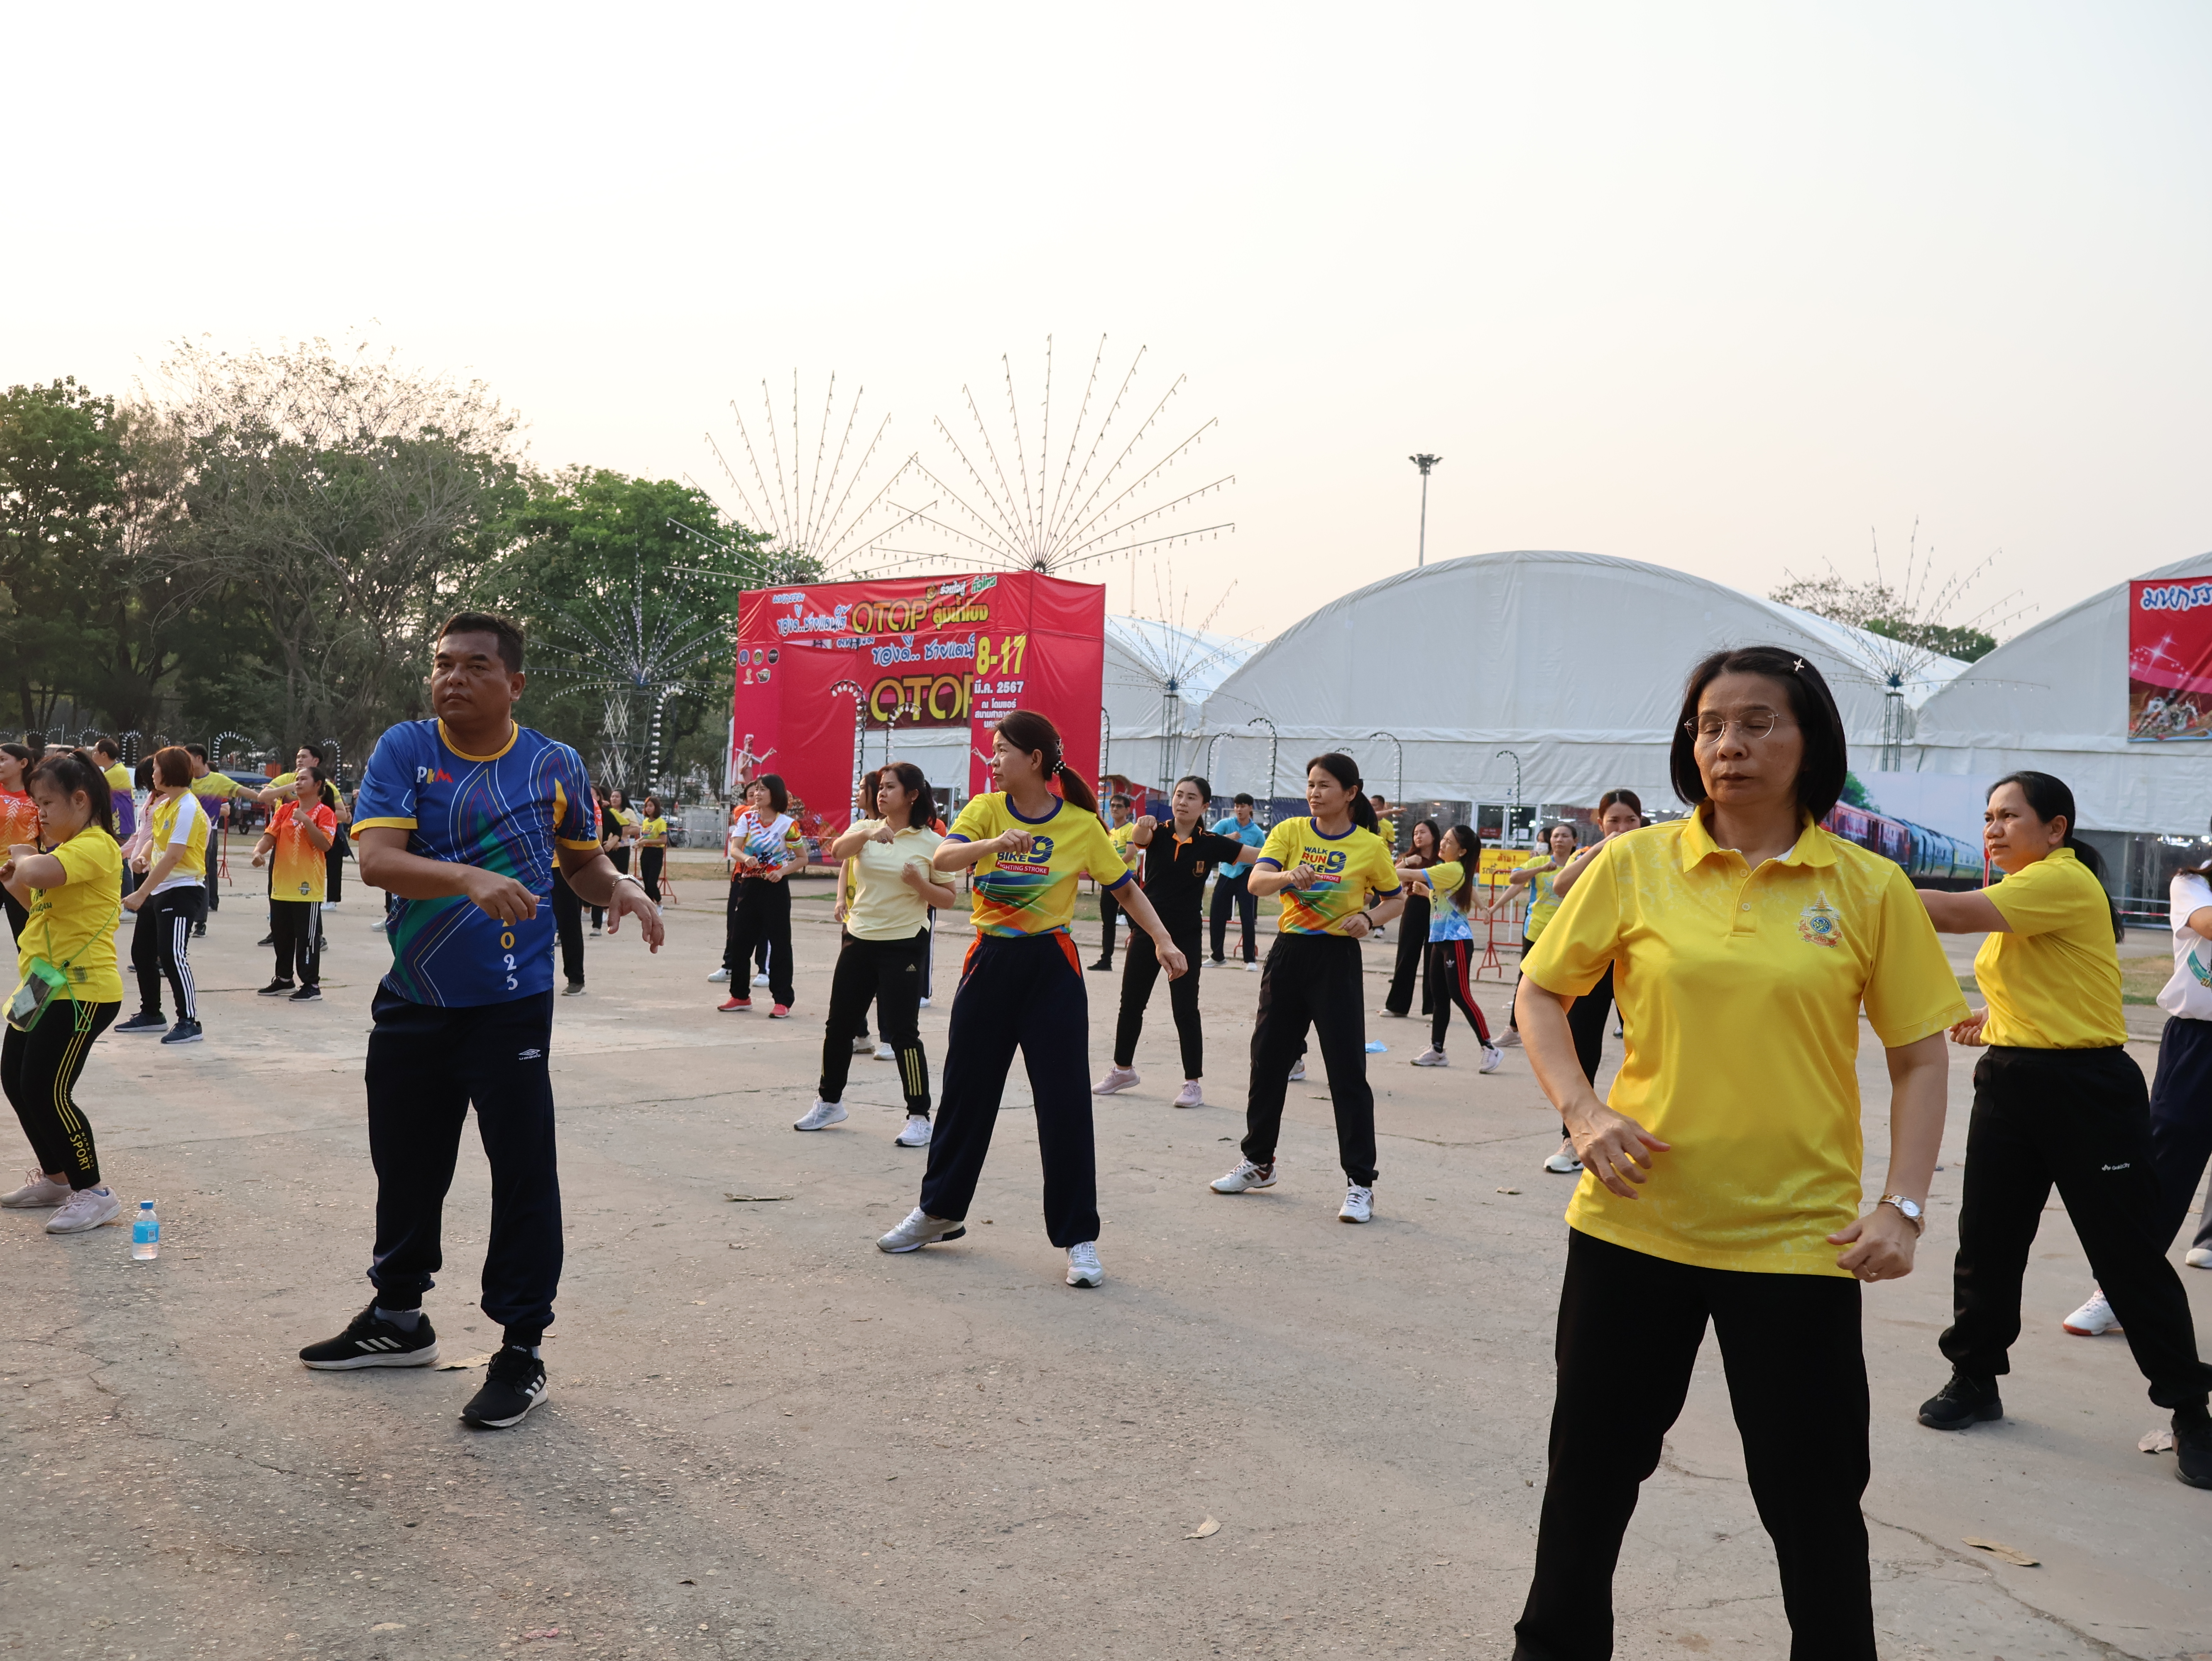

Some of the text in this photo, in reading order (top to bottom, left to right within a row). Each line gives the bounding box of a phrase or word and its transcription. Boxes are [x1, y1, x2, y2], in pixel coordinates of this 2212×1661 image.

[773, 592, 805, 604] มหกรรม
[851, 599, 929, 634] OTOP
[976, 635, 1026, 675] 8-17
[974, 679, 1024, 694] มี.ค. 2567
[981, 698, 1017, 709] ณ โดมแอร์
[1028, 835, 1054, 864] 9
[1304, 846, 1328, 855] WALK
[1302, 851, 1327, 864] RUN
[1324, 851, 1347, 874] 9
[997, 861, 1023, 871] FIGHTING
[1299, 860, 1324, 873] KE
[81, 1132, 90, 1151] WORK
[70, 1134, 90, 1170] SPORT
